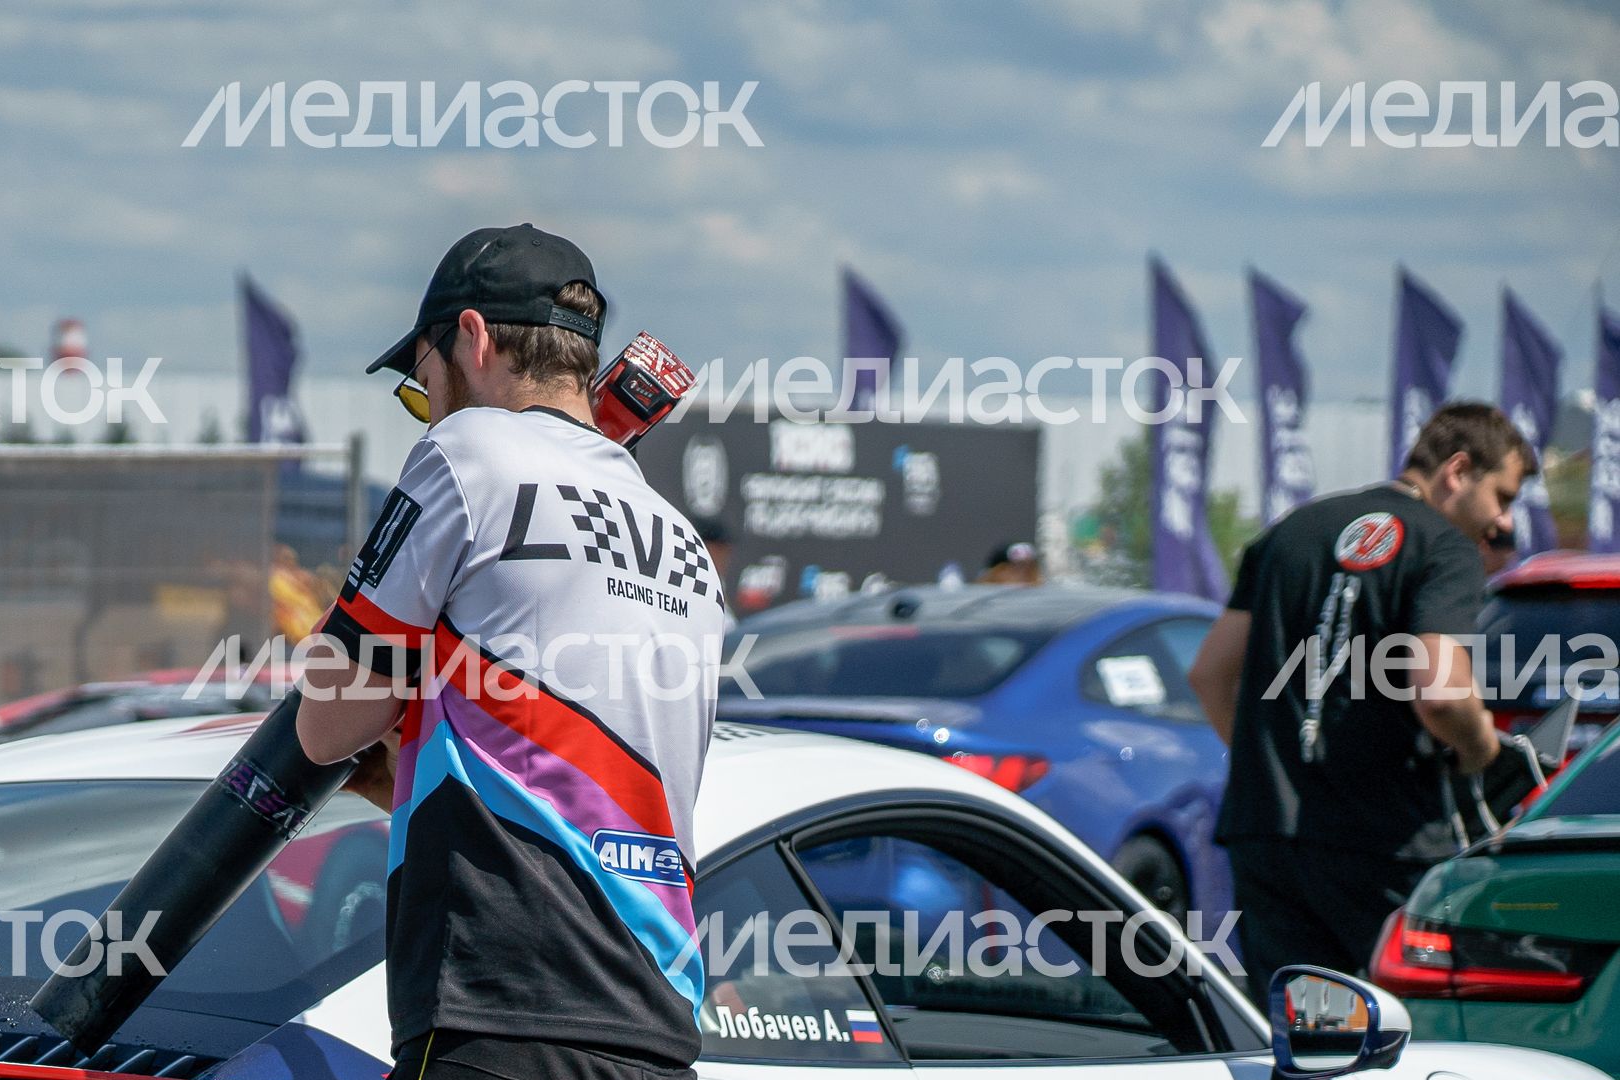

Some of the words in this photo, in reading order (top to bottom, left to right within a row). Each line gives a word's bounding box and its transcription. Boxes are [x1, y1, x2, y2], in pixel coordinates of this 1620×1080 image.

[607, 577, 653, 606] RACING
[656, 591, 688, 618] TEAM
[716, 1006, 821, 1041] Лобачев
